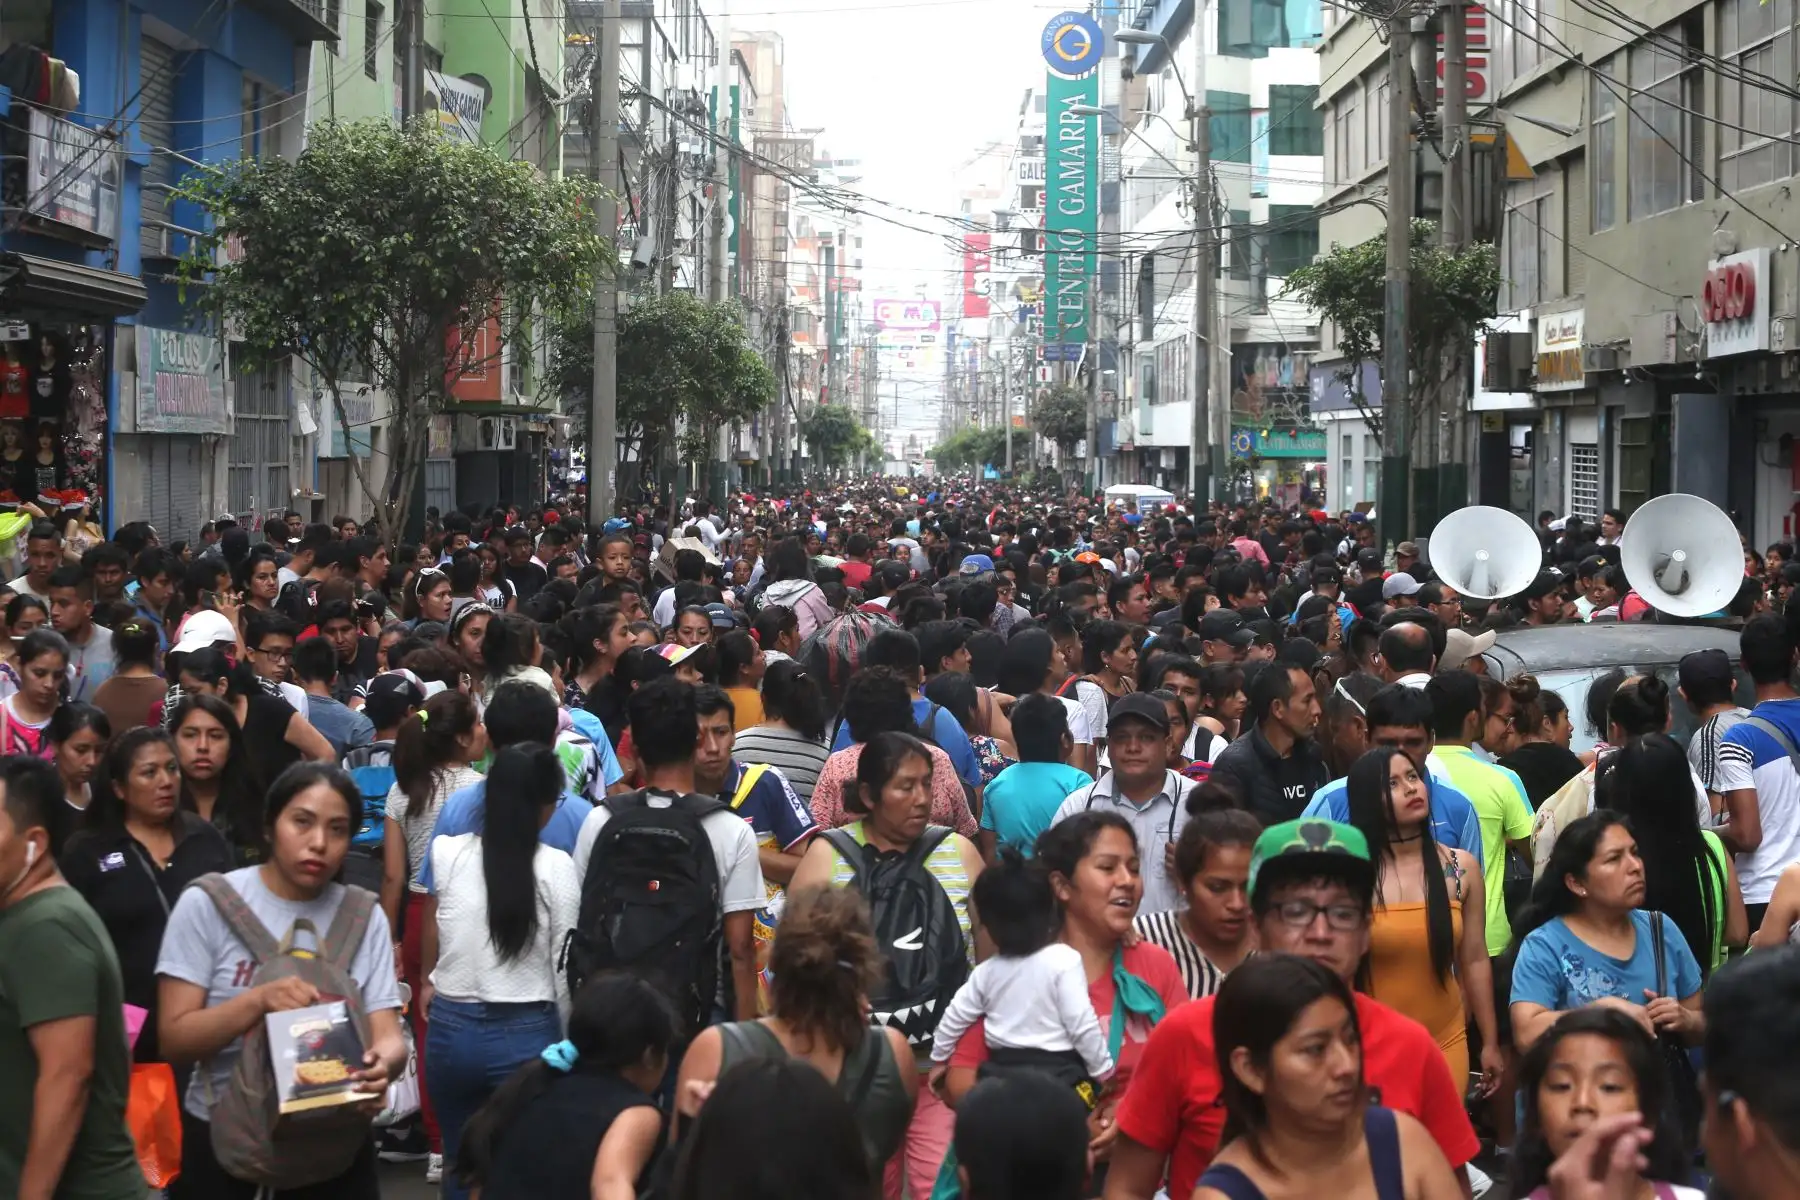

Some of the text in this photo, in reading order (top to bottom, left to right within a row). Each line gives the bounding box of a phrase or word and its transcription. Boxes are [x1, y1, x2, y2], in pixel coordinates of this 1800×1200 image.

[1058, 92, 1086, 216] GAMARRA
[1058, 228, 1085, 329] CENTRO
[160, 331, 201, 367] POLOS
